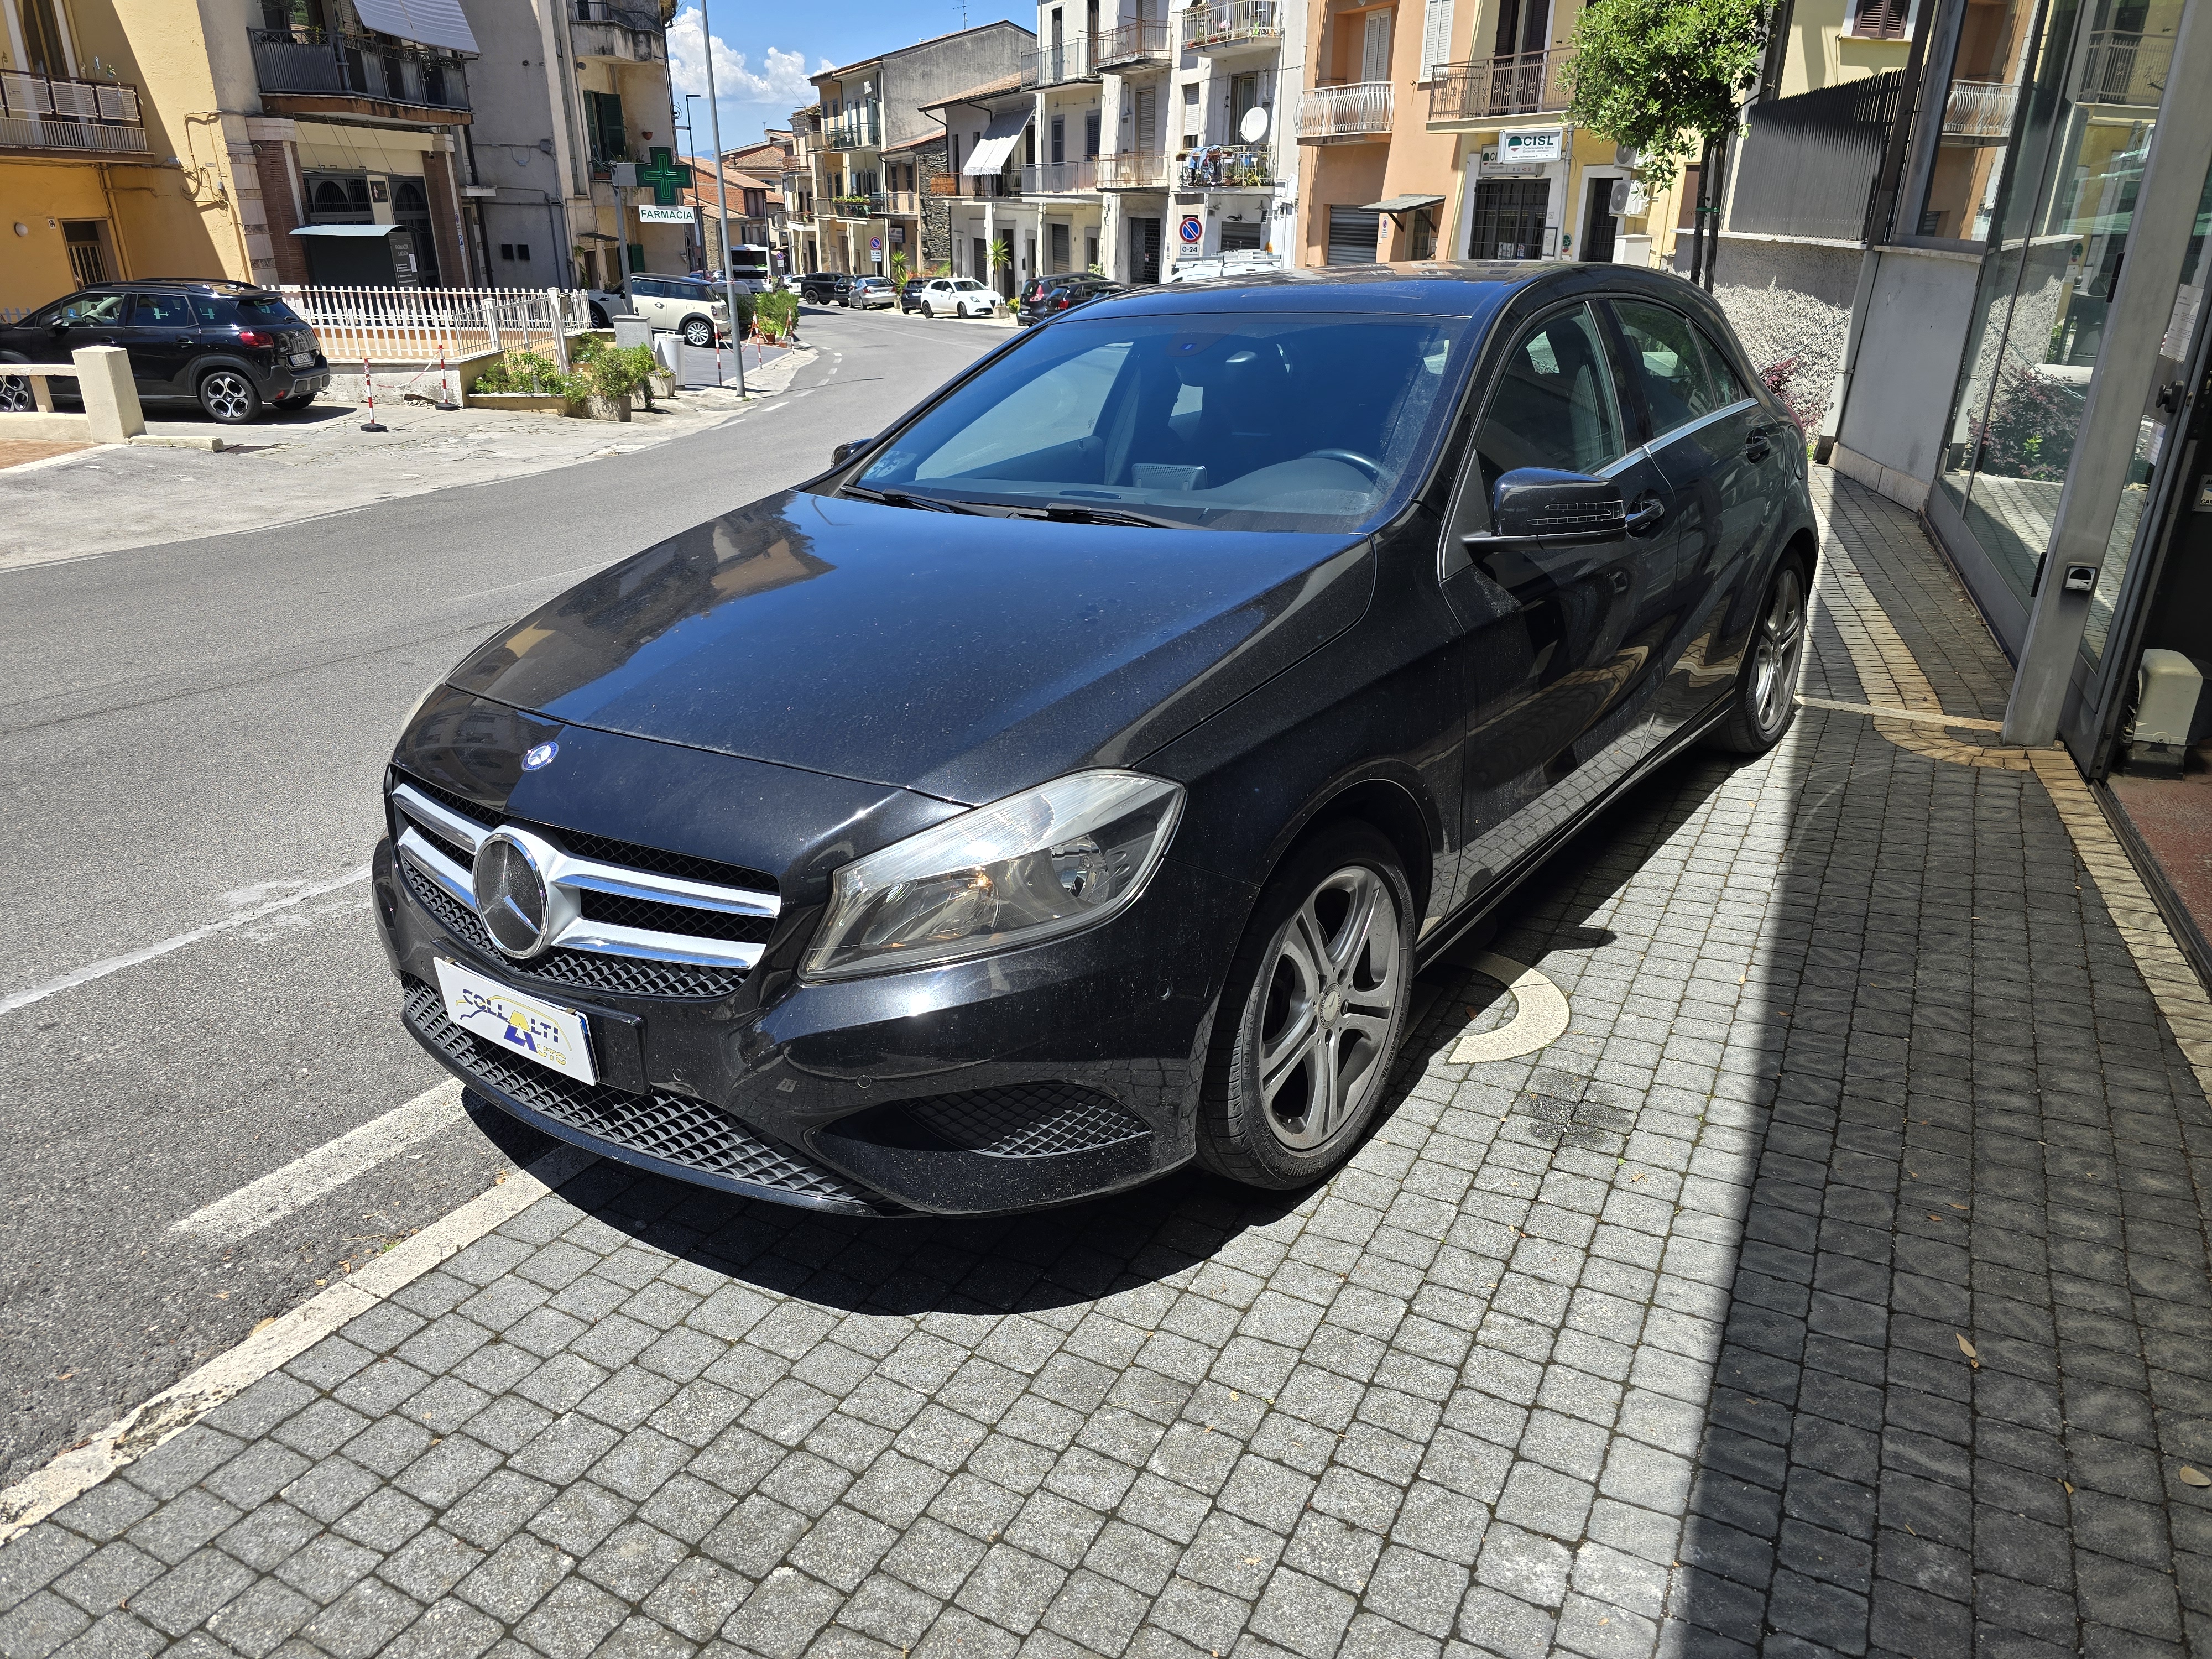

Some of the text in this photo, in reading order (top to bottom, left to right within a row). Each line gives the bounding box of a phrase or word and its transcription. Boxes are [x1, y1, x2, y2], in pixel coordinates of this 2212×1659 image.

[1524, 135, 1553, 146] CISL
[641, 210, 693, 220] FARMACIA
[1242, 985, 1261, 1079] POTENZA
